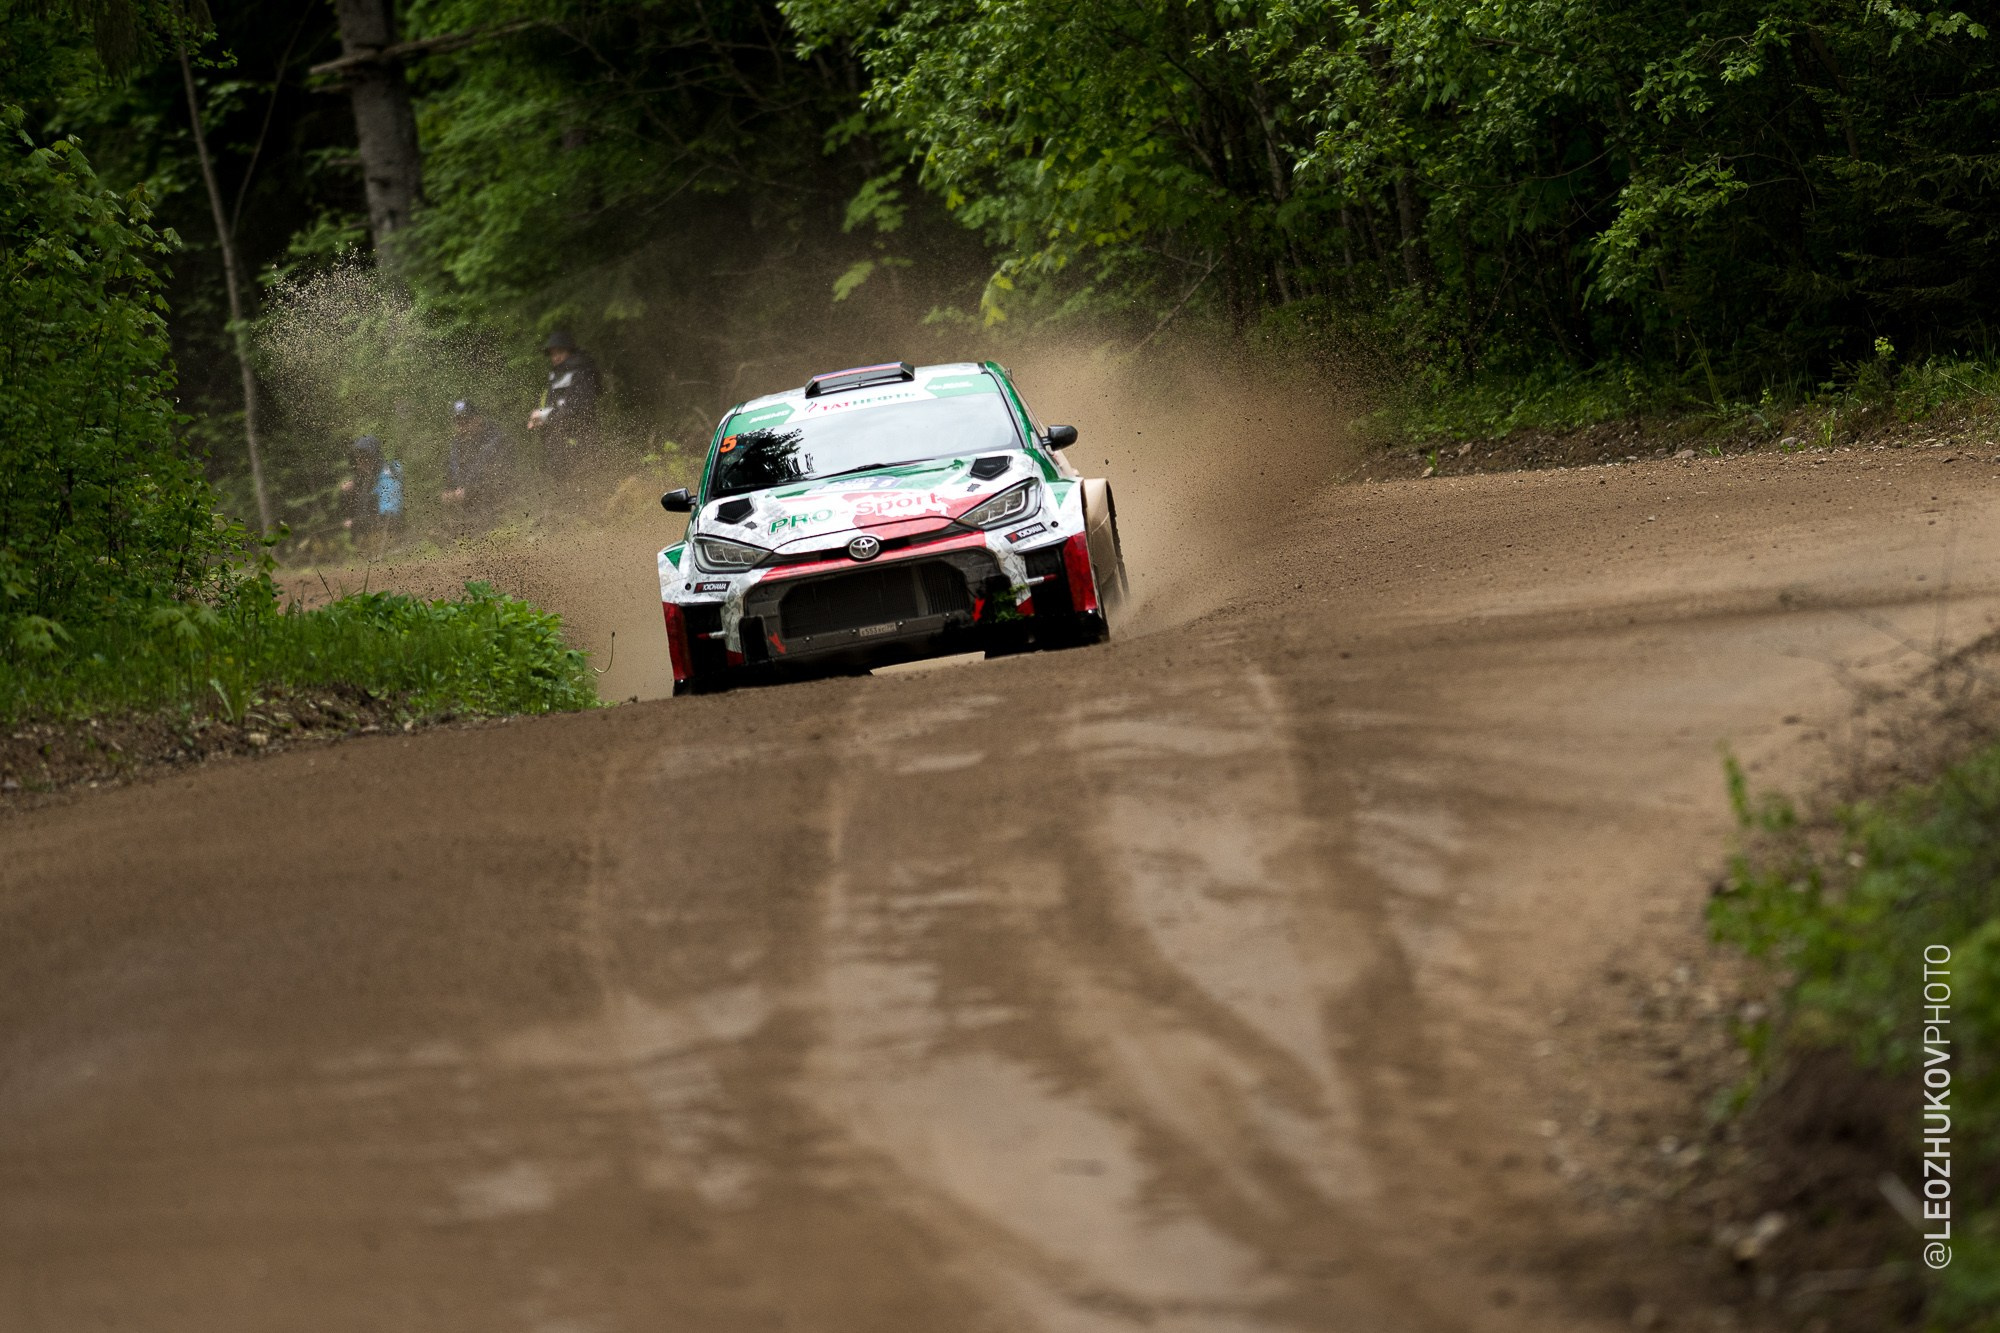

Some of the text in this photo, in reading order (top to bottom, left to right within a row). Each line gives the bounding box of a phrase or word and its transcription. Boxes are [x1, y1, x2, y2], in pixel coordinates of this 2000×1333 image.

[720, 435, 737, 453] 5
[768, 508, 834, 535] PRO
[855, 492, 941, 516] Sport
[702, 583, 727, 591] YOKOHAMA
